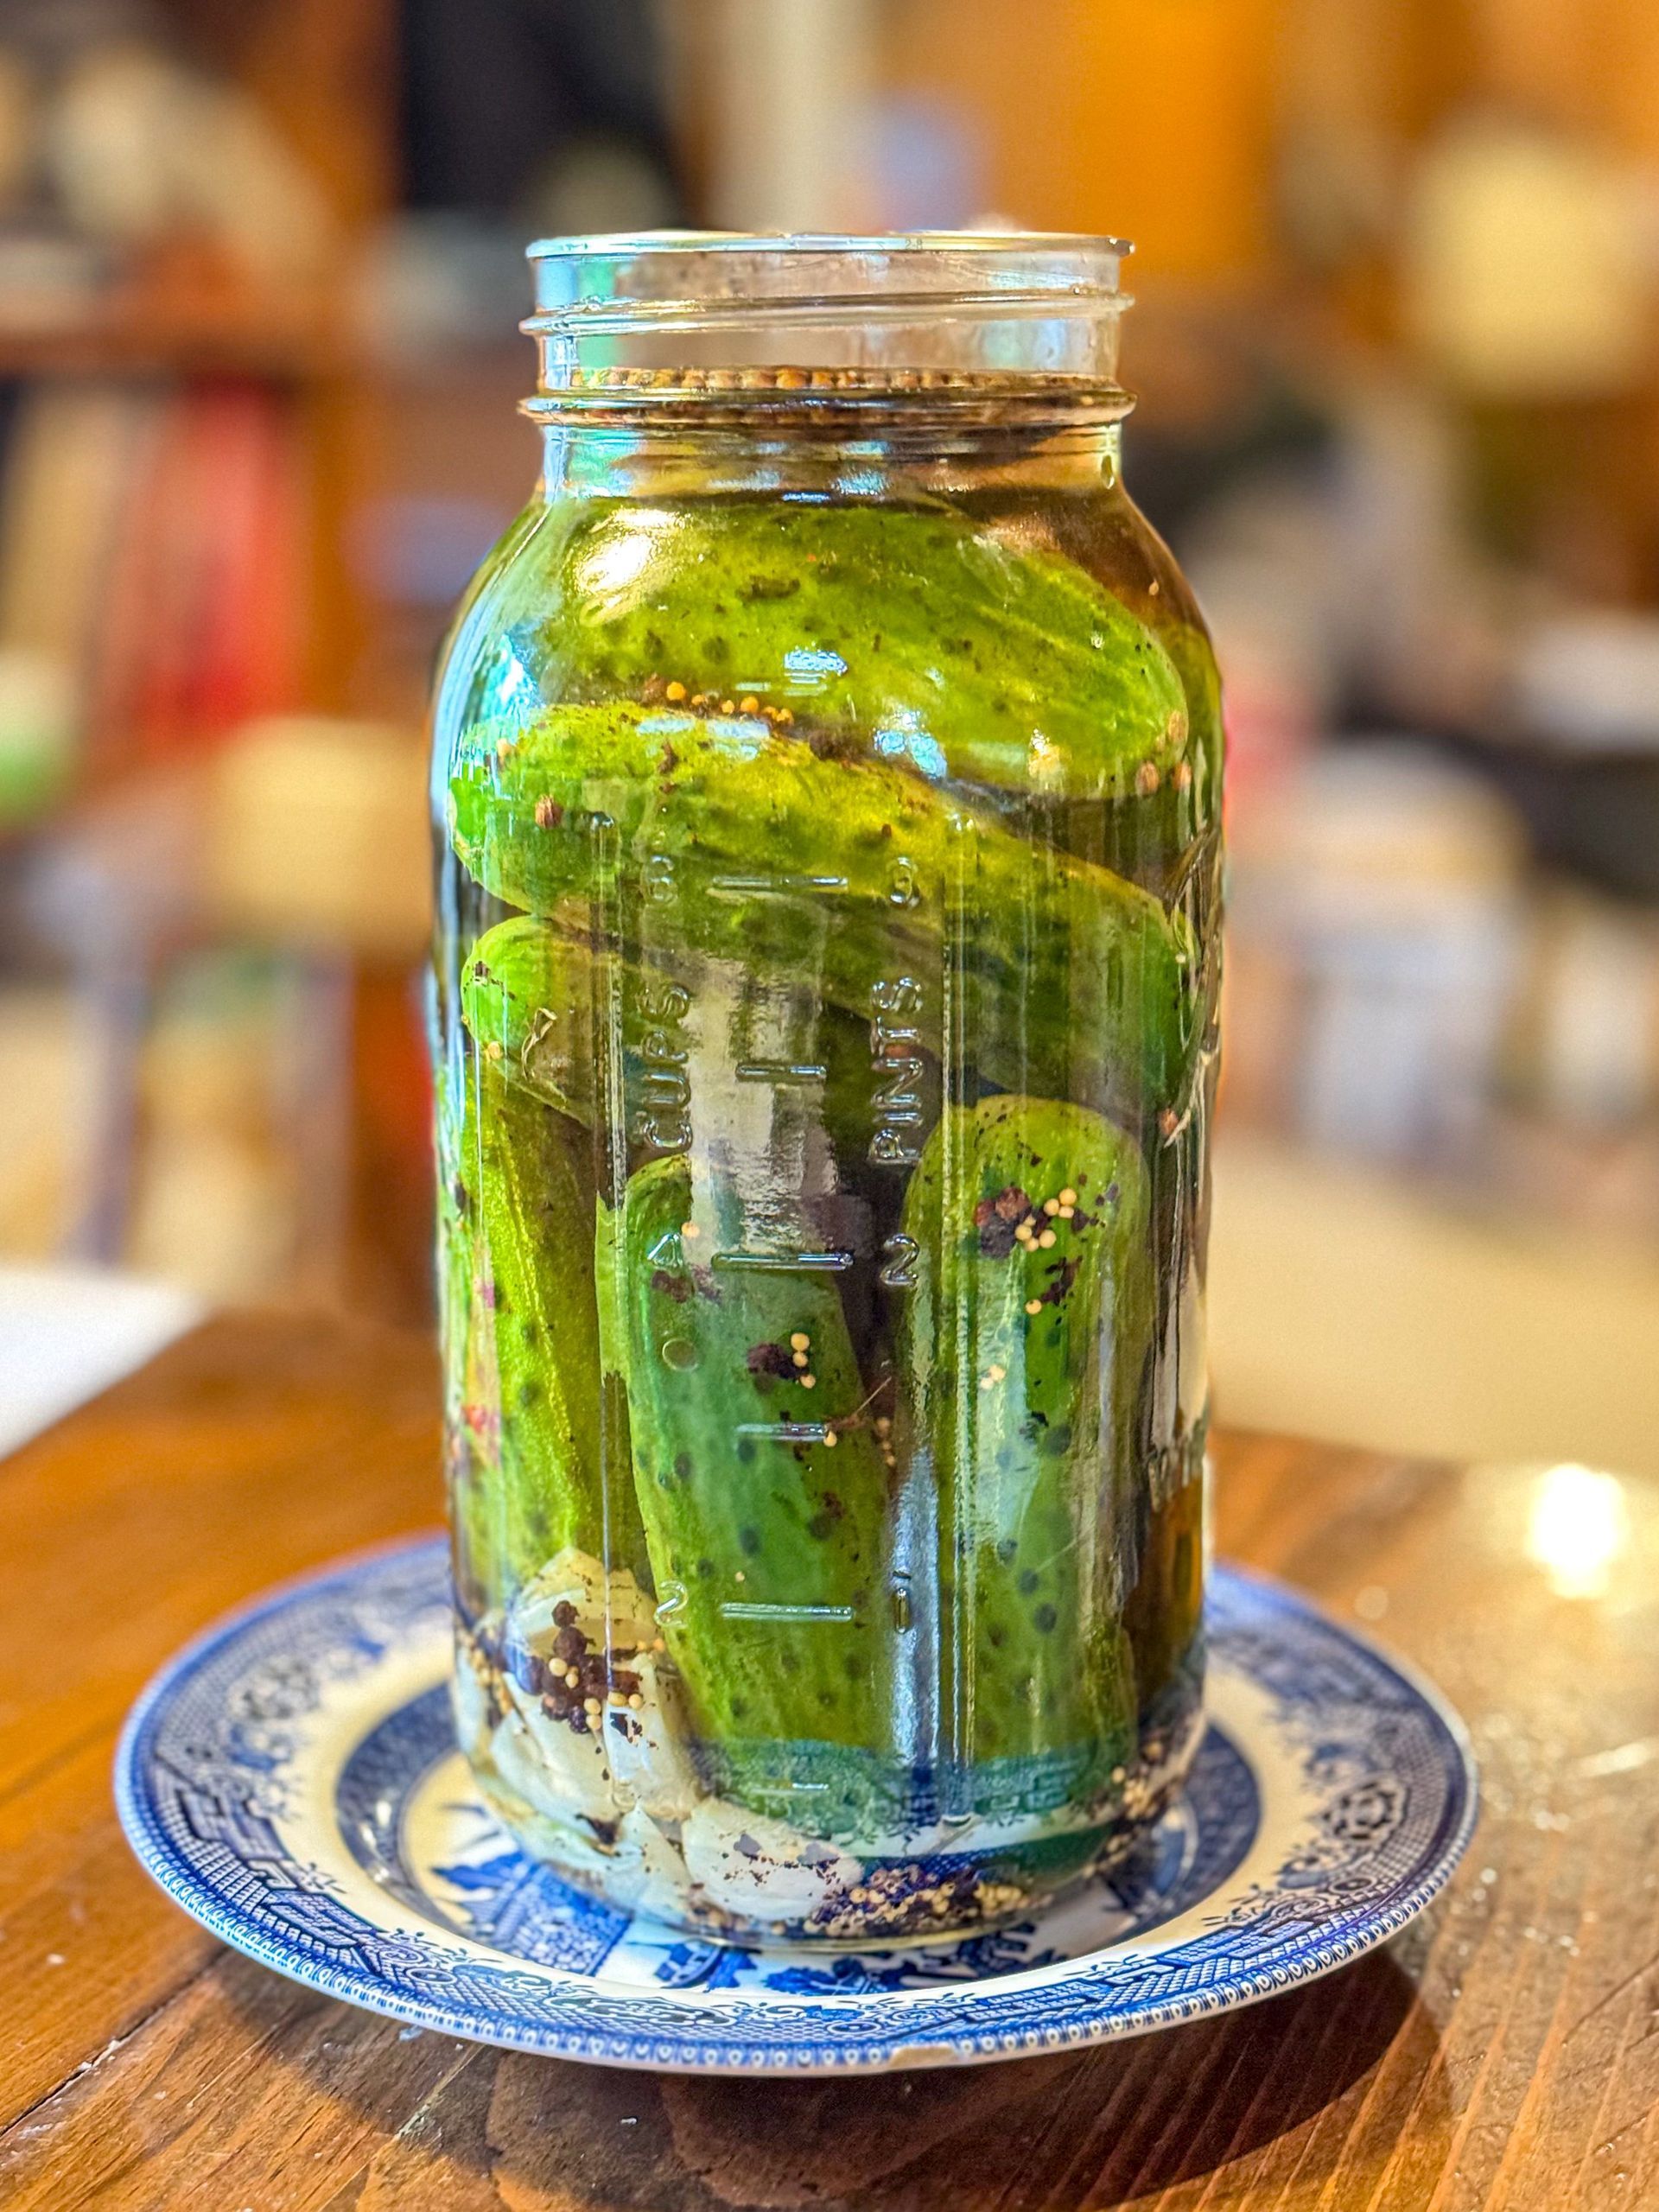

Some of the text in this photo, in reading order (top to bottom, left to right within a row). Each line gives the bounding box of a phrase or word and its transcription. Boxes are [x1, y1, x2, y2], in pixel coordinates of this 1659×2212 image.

[637, 980, 692, 1147] CUPS
[871, 976, 923, 1165] PINTS
[646, 1231, 683, 1275] 4
[880, 1232, 920, 1287] 2
[654, 1580, 688, 1629] 2
[893, 1586, 912, 1635] 1
